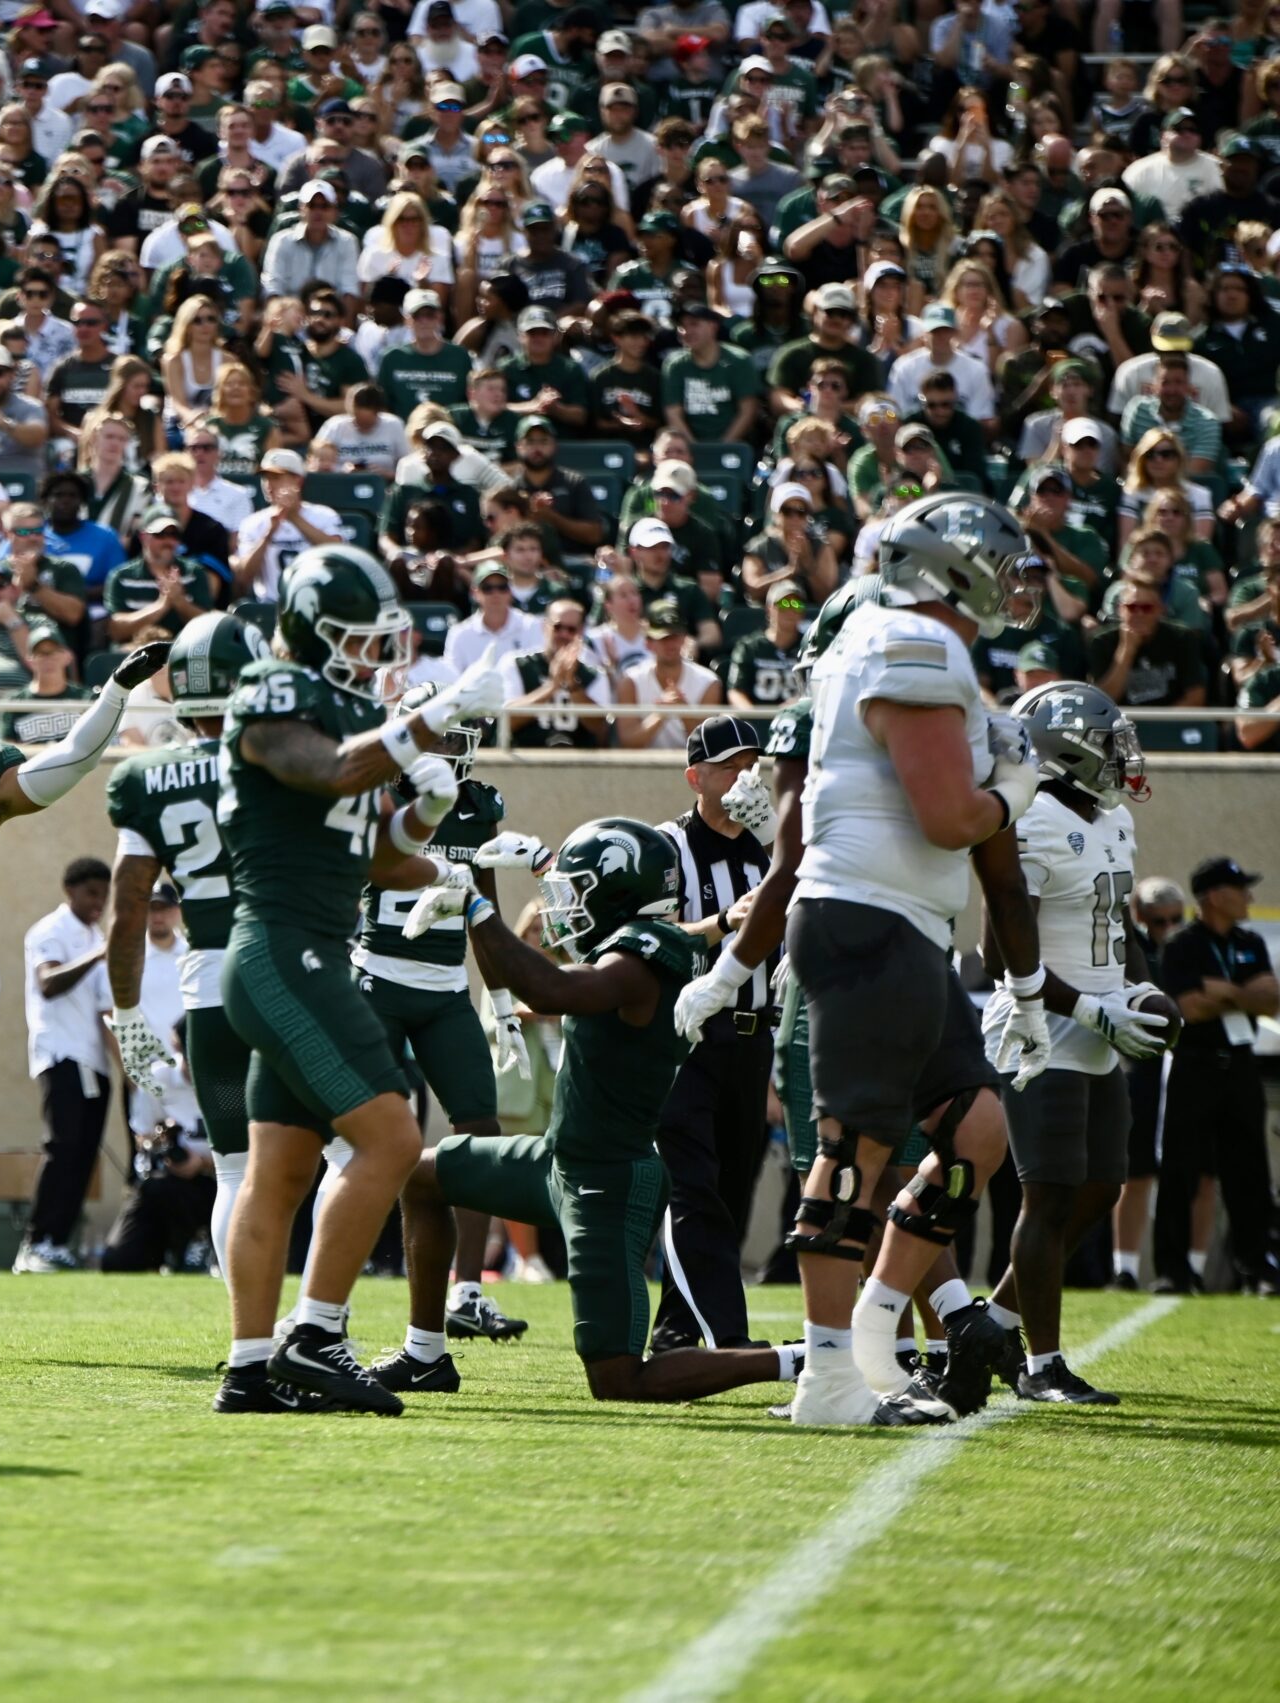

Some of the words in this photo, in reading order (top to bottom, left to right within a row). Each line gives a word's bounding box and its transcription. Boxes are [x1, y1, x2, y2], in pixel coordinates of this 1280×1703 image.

[942, 501, 985, 545] E
[1046, 694, 1084, 730] E
[160, 799, 230, 899] 2
[421, 844, 447, 858] GAN
[1092, 870, 1133, 968] 15
[638, 932, 661, 960] 3
